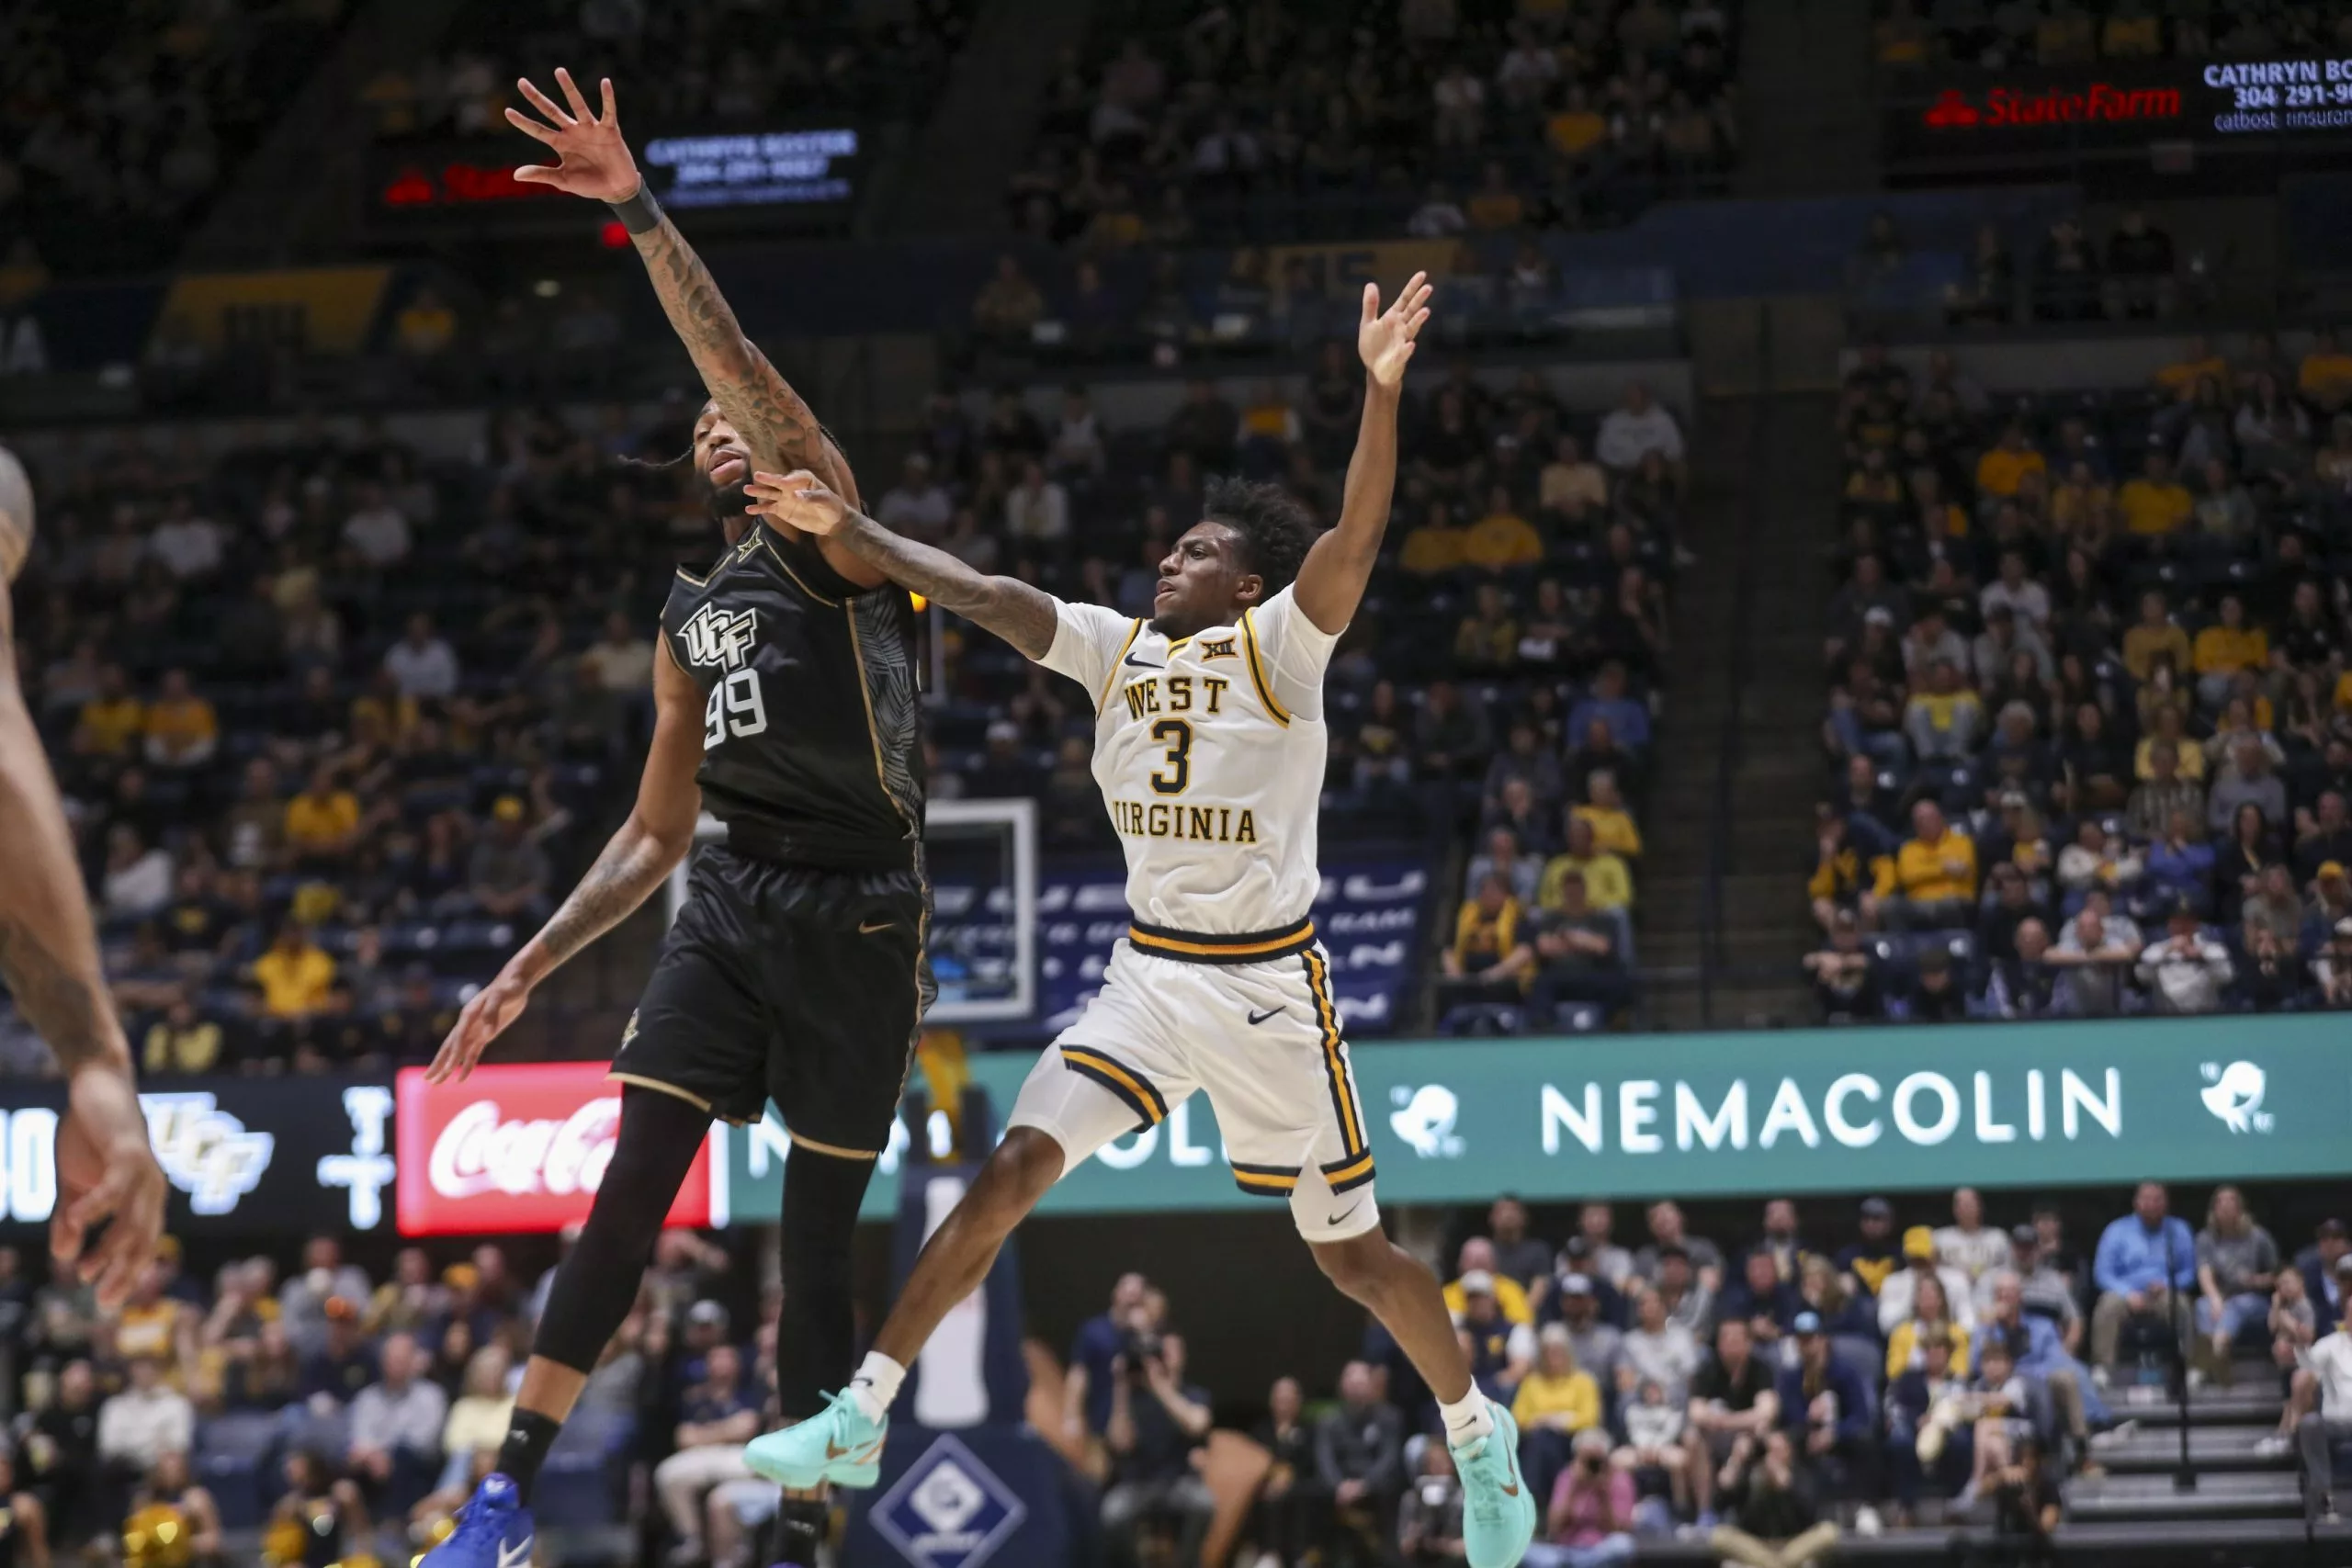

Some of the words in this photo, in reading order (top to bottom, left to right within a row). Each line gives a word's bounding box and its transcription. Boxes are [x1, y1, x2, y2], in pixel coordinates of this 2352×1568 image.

[2203, 61, 2317, 88] CATHRYN
[677, 602, 758, 671] UCF
[1200, 636, 1238, 662] XII
[704, 667, 768, 750] 99
[1124, 675, 1229, 721] WEST
[1149, 716, 1193, 796] 3
[1113, 800, 1257, 843] VIRGINIA
[1541, 1067, 2122, 1156] NEMACOLIN
[0, 1108, 58, 1223] 0
